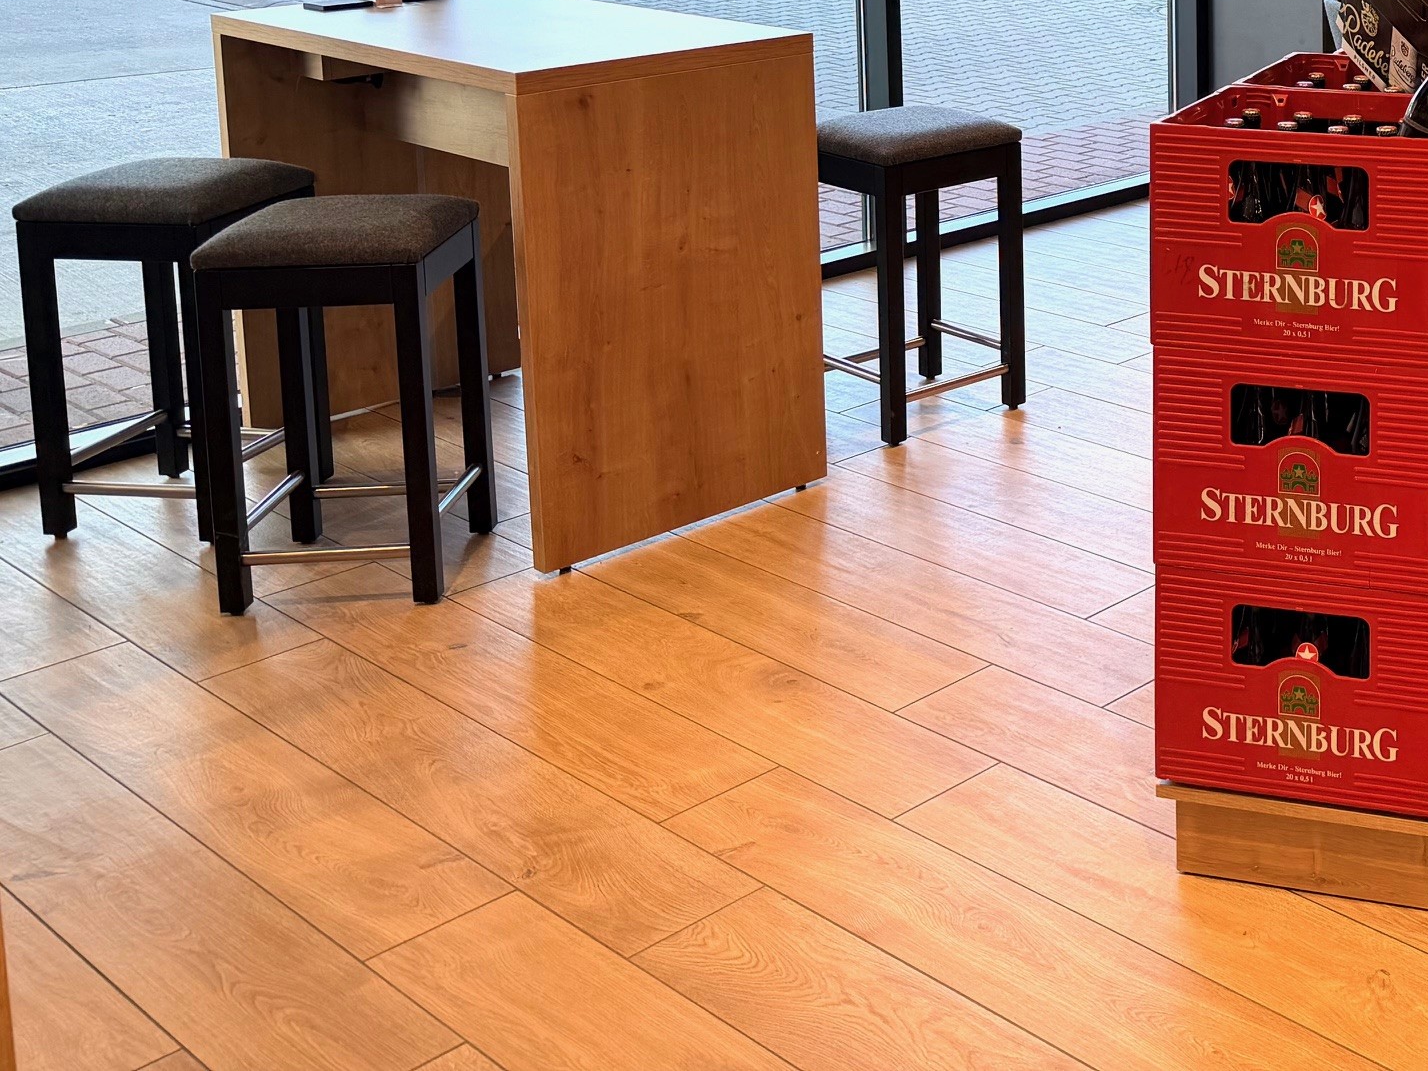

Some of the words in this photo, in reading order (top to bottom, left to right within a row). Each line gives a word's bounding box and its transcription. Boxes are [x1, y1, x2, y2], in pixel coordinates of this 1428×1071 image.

[1353, 54, 1376, 80] PILSNER
[1198, 264, 1398, 313] STERNBURG
[1254, 318, 1273, 326] Merke
[1274, 319, 1286, 327] Dir
[1292, 321, 1323, 331] Sternburg
[1324, 324, 1340, 332] Bier!
[1201, 487, 1399, 539] STERNBURG
[1255, 542, 1275, 550] Merke
[1277, 543, 1288, 551] Dir
[1294, 545, 1325, 556] Sternburg
[1326, 548, 1342, 557] Bier!
[1202, 706, 1399, 762] STERNBURG
[1256, 761, 1277, 770] Merke
[1278, 762, 1289, 771] Dir
[1295, 765, 1326, 777] Sternburg
[1326, 769, 1342, 779] Bier!
